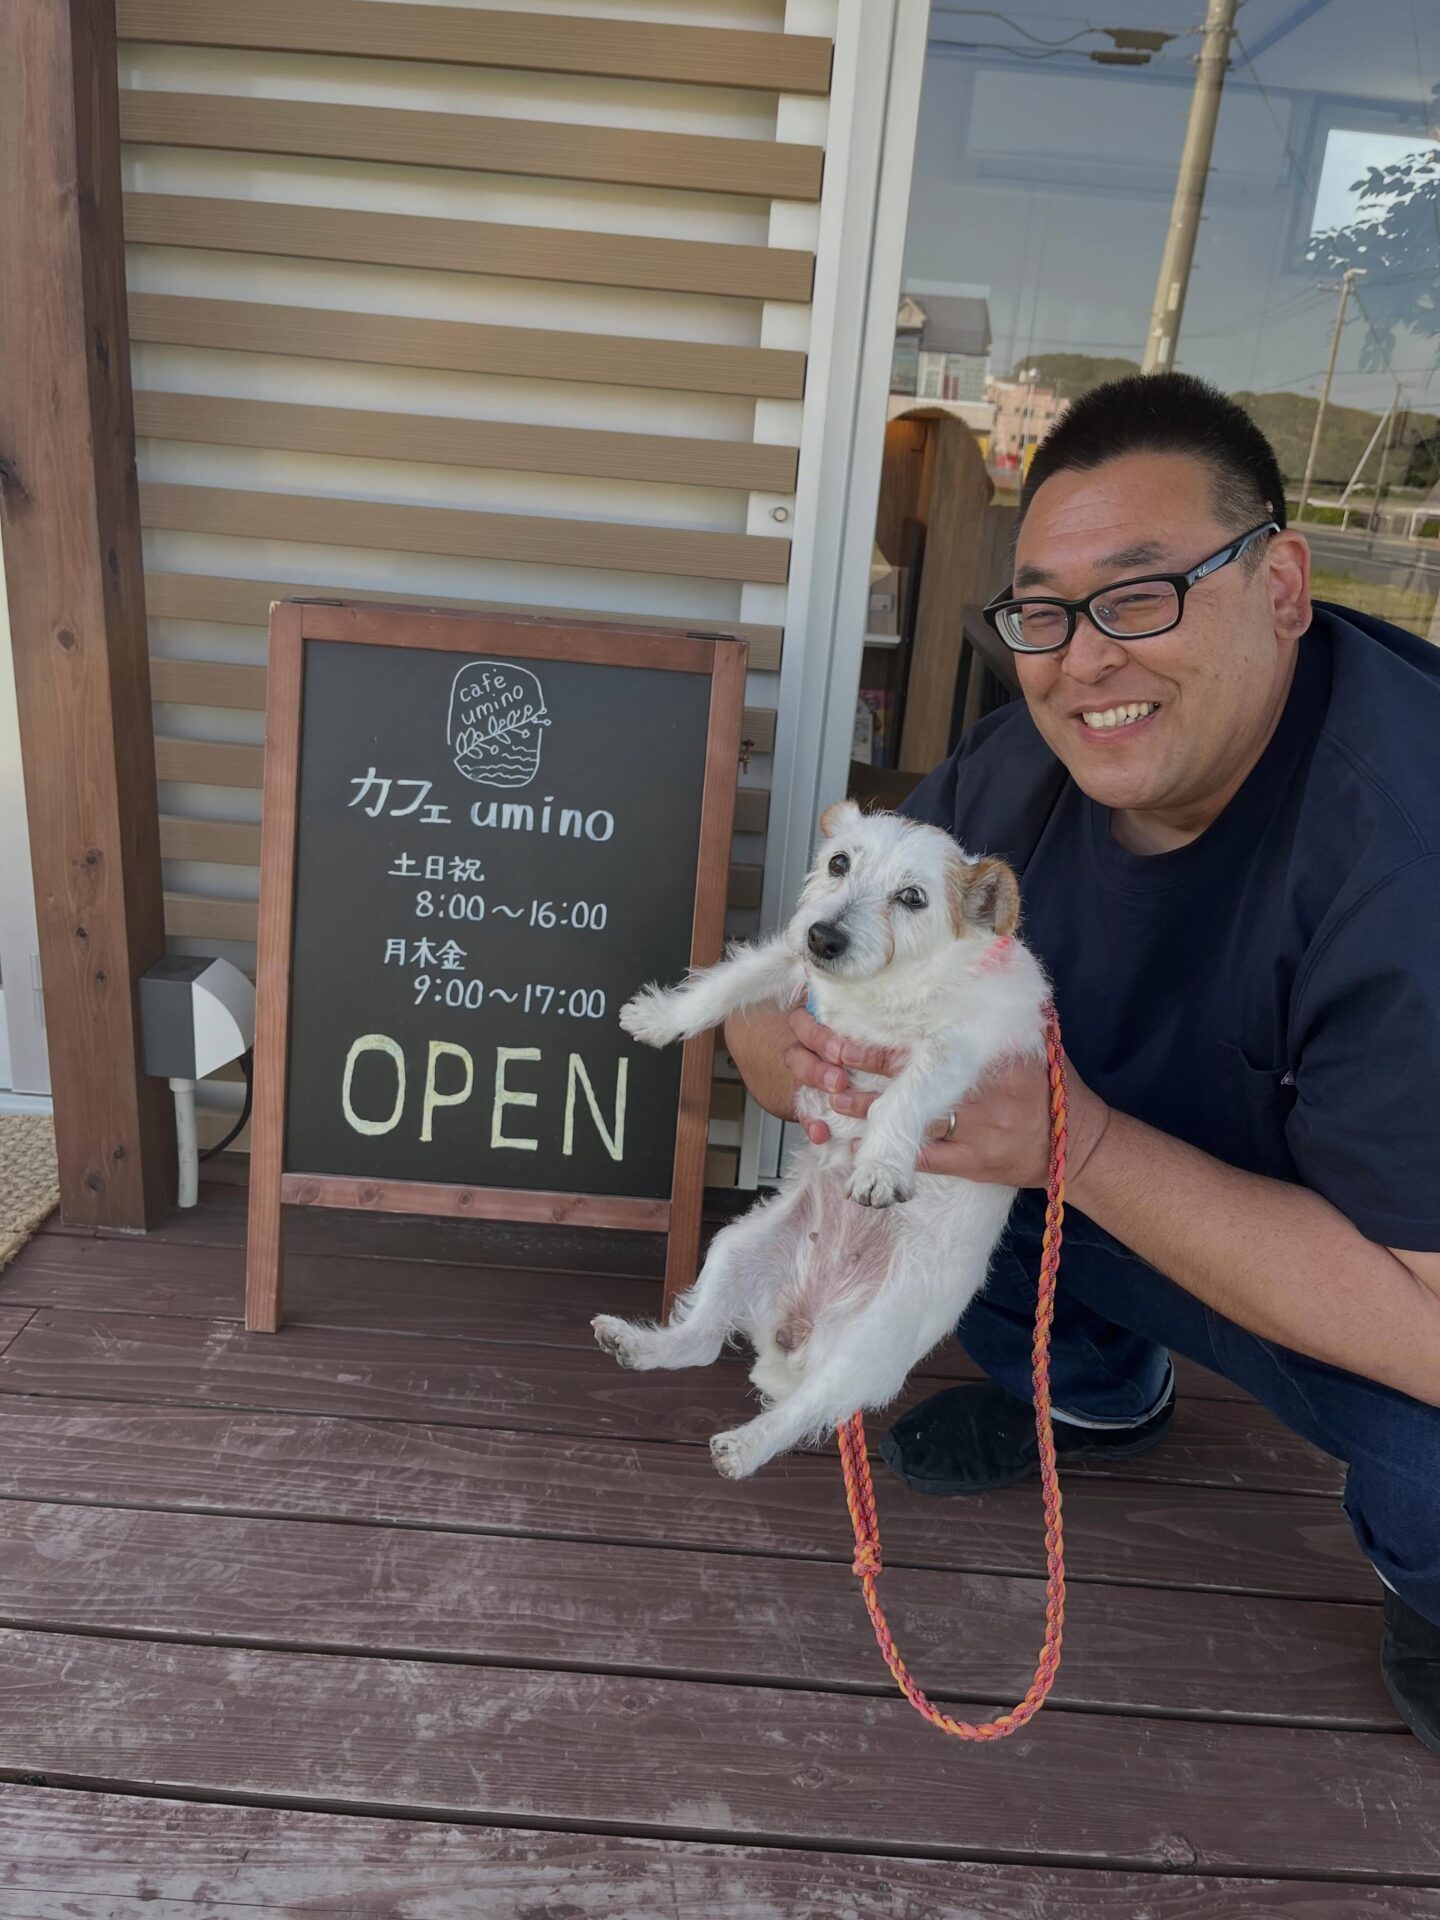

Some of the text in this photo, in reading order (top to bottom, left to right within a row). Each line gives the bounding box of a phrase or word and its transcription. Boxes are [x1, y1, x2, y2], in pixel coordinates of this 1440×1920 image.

[461, 685, 524, 725] umino
[348, 767, 614, 841] カフェ umino
[388, 852, 485, 882] 土日祝
[384, 937, 467, 970] 月木金
[342, 1033, 629, 1161] OPEN
